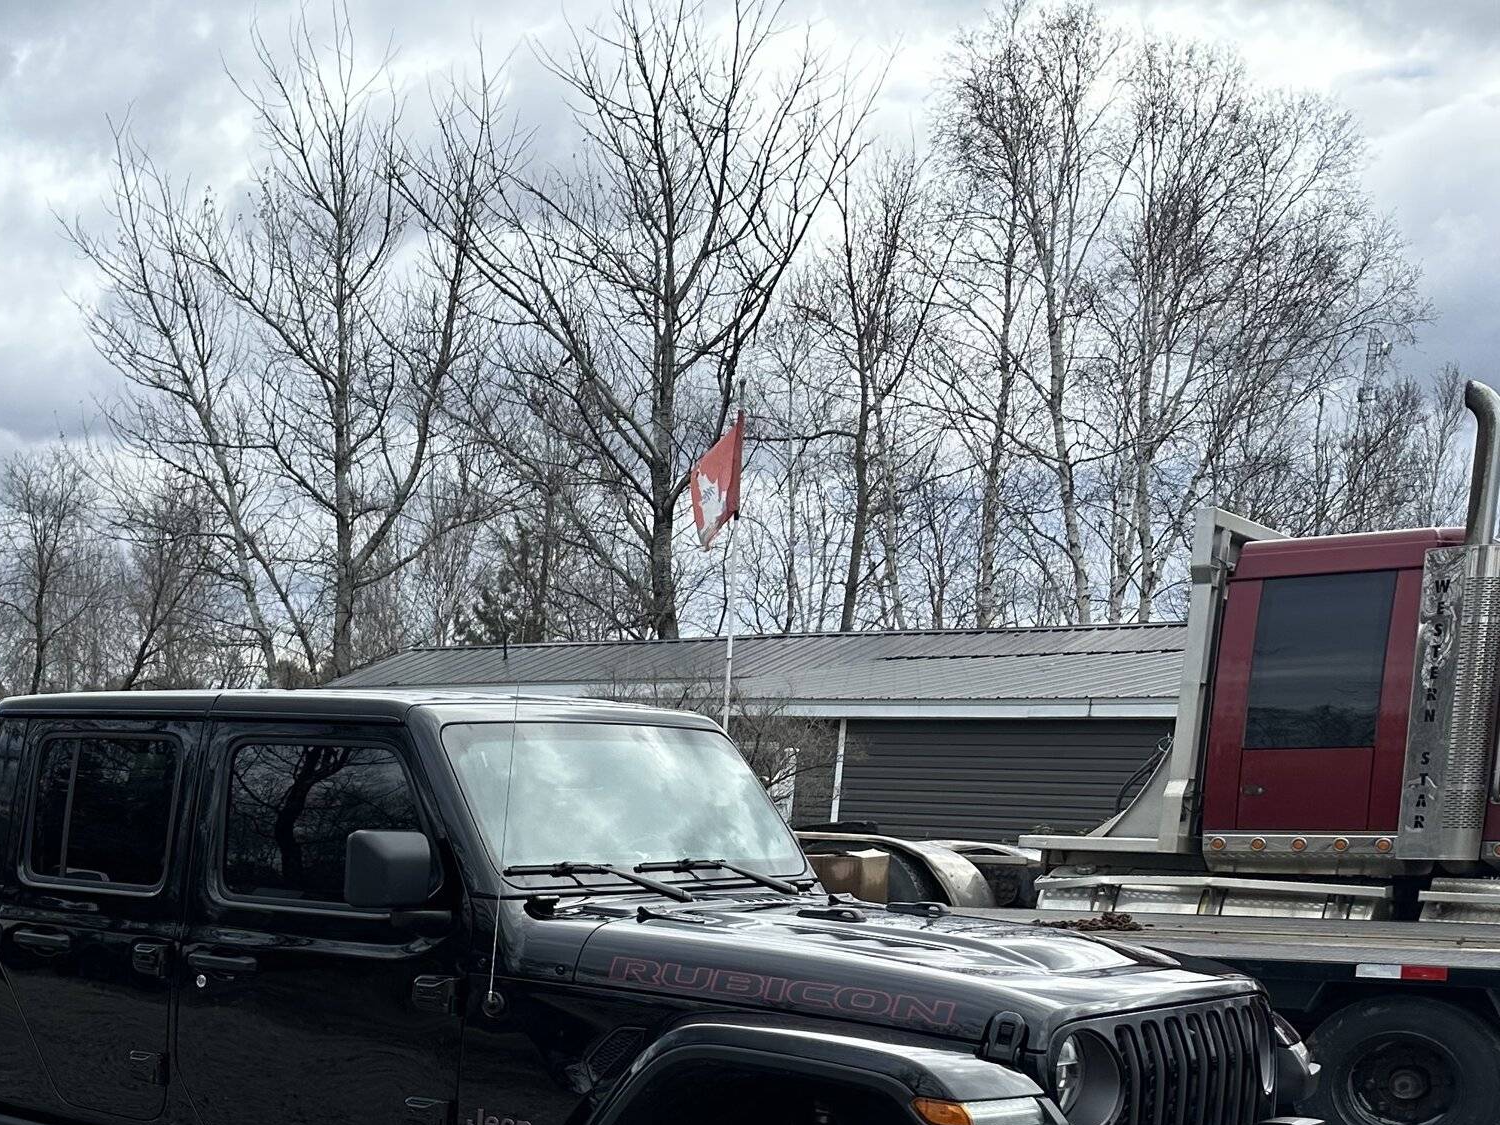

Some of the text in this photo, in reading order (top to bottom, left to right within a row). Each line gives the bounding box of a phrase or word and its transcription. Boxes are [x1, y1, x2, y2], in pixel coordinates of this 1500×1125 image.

[1413, 579, 1451, 829] WESTERN STAR
[609, 956, 956, 1026] RUBICON
